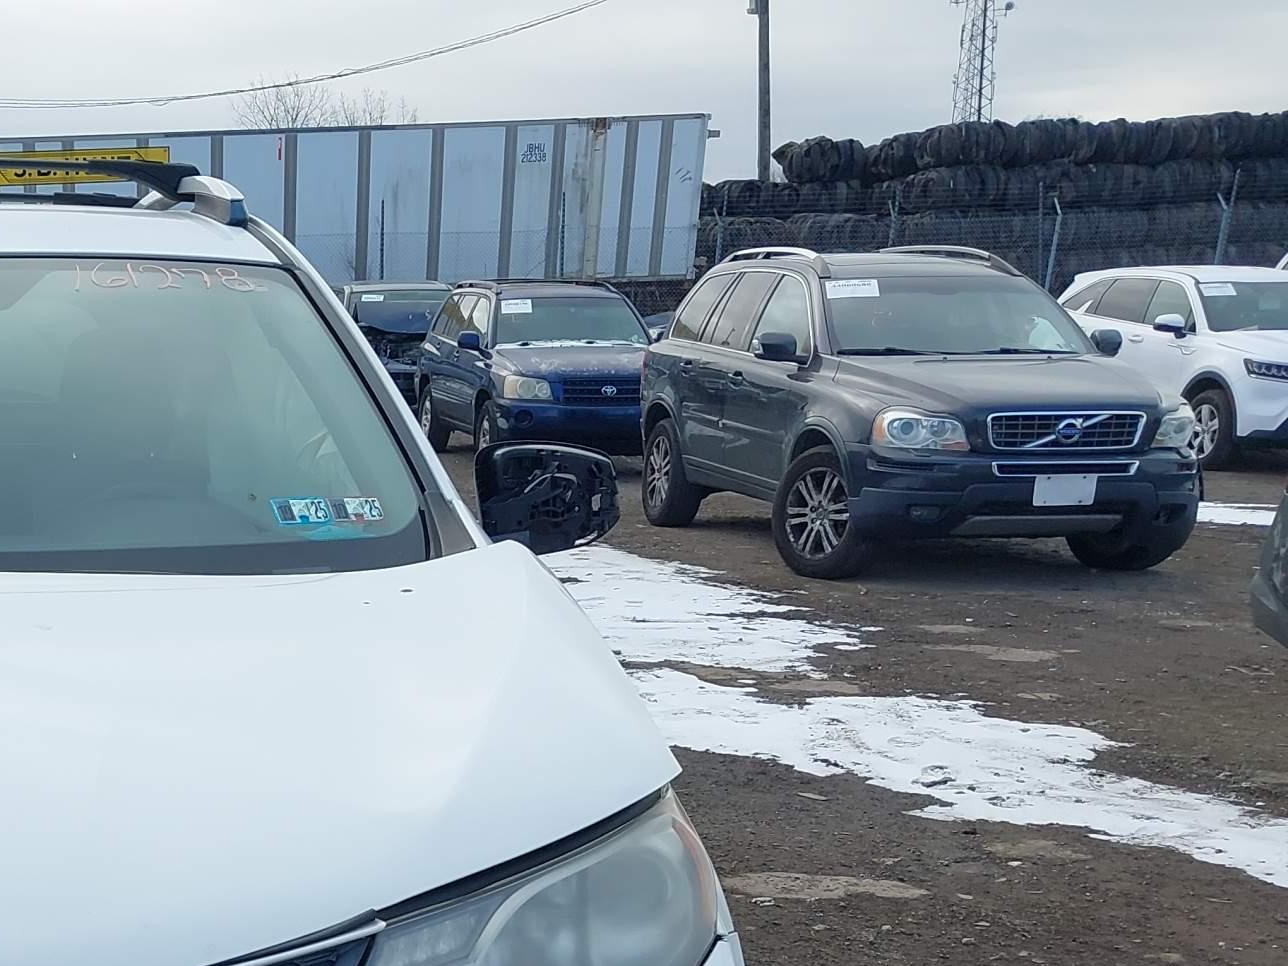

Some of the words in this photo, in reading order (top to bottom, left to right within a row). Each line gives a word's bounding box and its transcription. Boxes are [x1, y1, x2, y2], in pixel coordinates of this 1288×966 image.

[524, 143, 546, 153] JBHU
[310, 500, 329, 520] 25
[365, 499, 383, 518] 25
